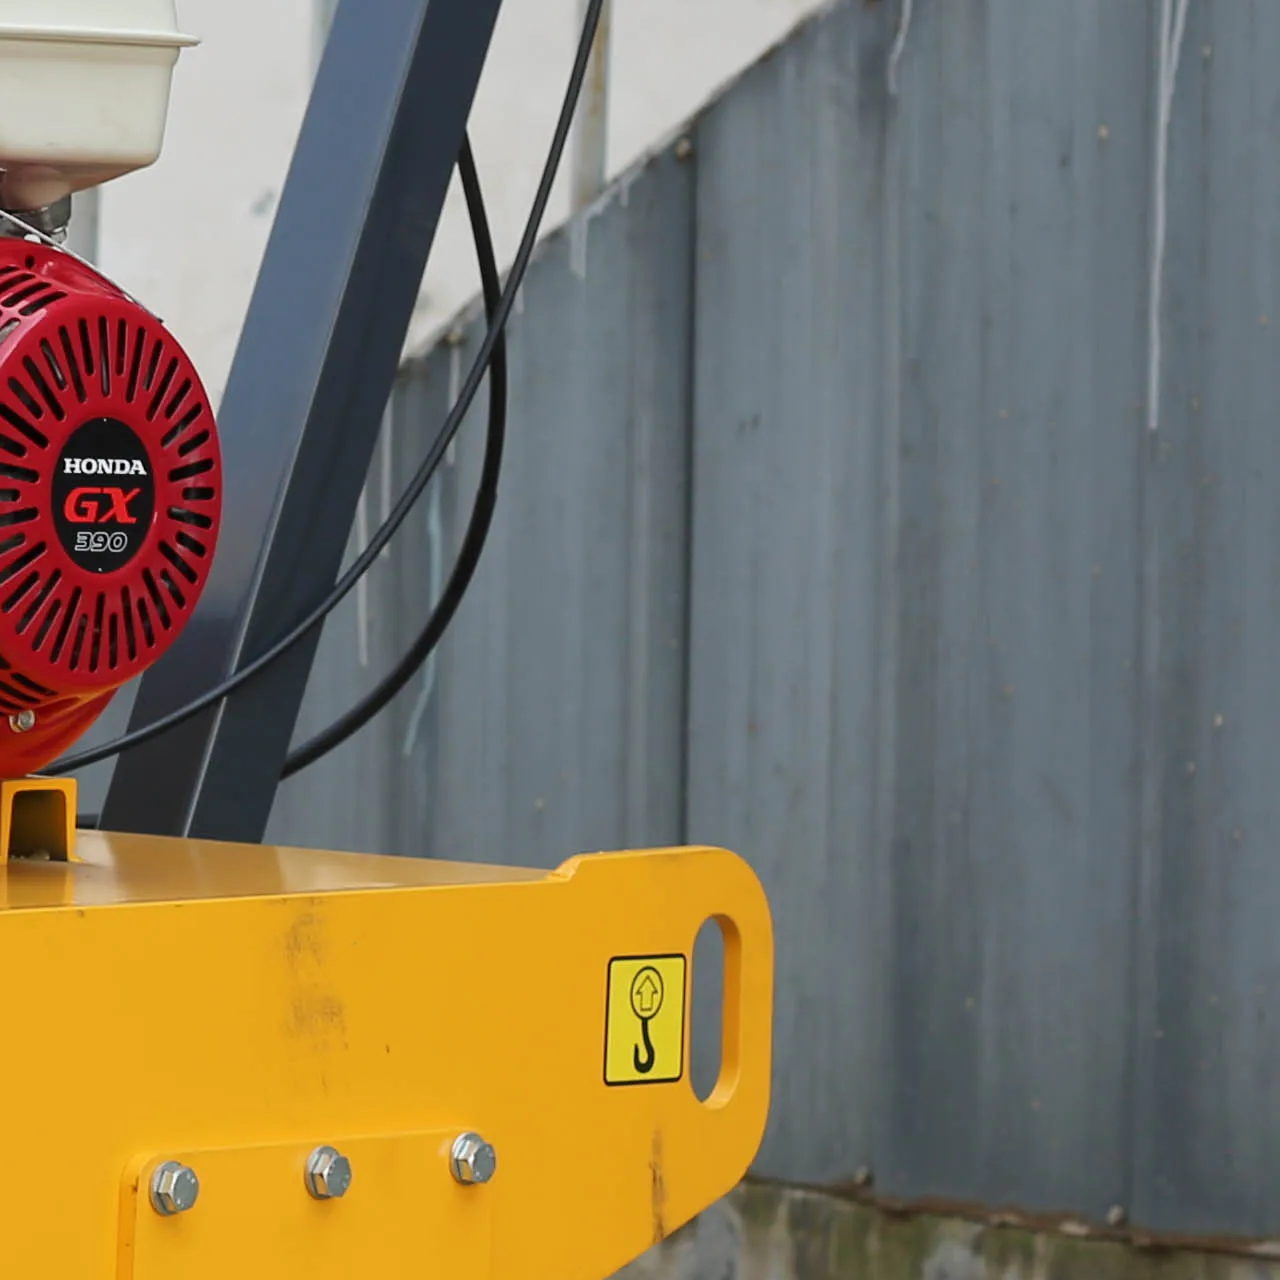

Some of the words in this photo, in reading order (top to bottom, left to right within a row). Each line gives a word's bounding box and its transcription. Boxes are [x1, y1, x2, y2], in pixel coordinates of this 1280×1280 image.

[63, 458, 147, 476] HONDA
[64, 487, 141, 524] GX
[74, 531, 128, 553] 390
